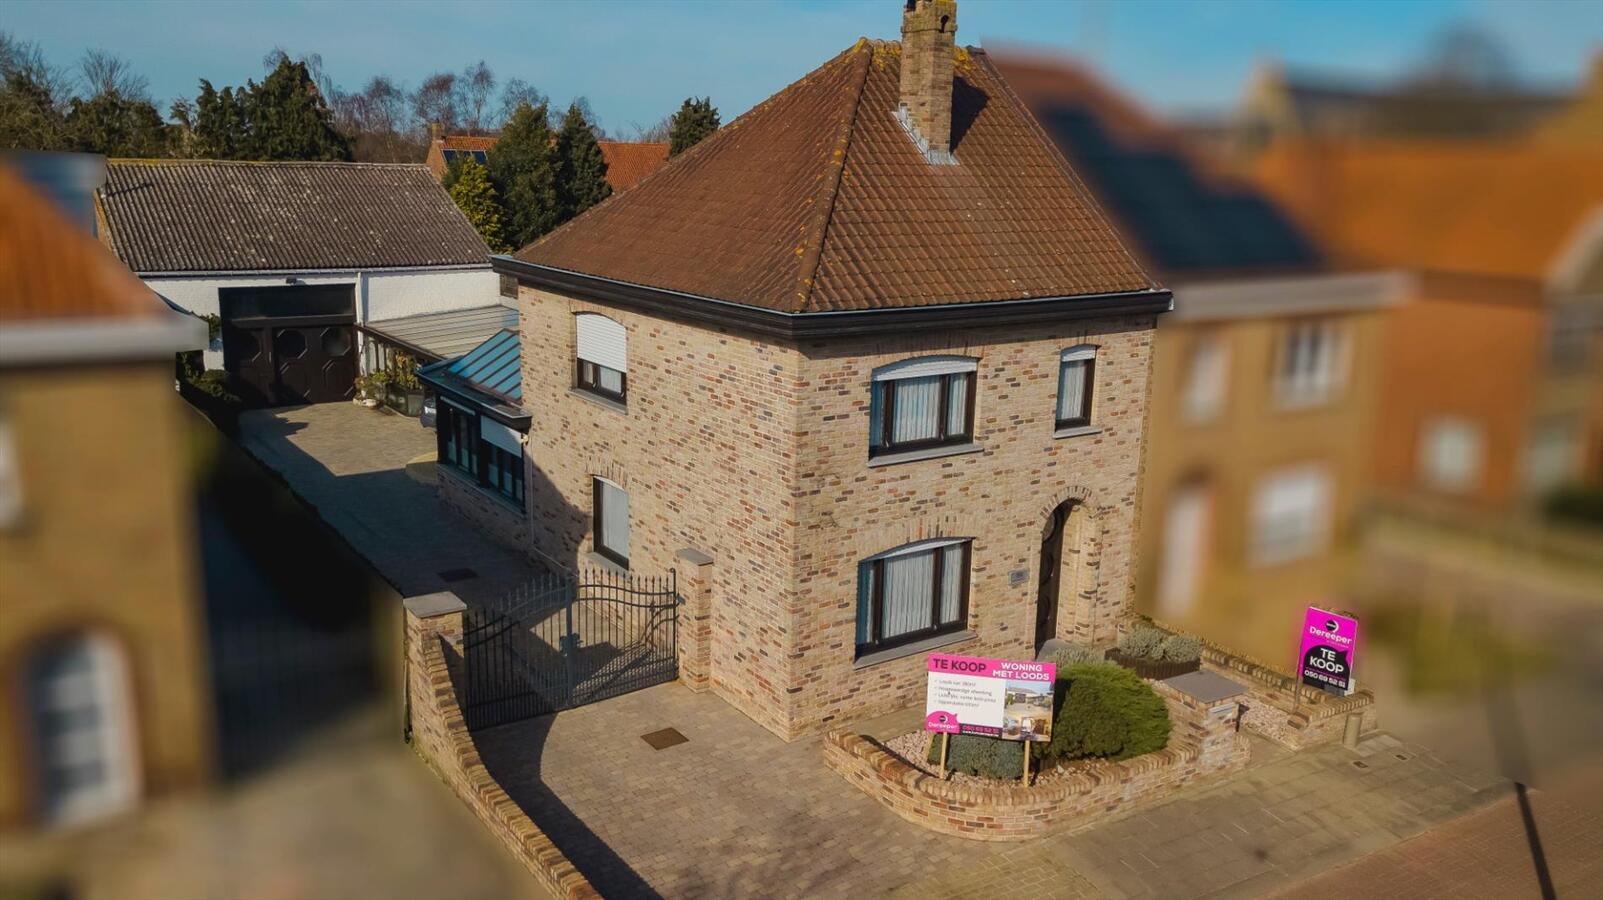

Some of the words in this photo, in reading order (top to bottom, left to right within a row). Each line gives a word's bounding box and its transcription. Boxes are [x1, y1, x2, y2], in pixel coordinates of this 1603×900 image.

[1309, 626, 1352, 645] Dereeper
[1320, 648, 1336, 661] TE
[933, 658, 948, 669] TE
[951, 660, 986, 673] KOOP
[1001, 662, 1043, 672] WONING
[1309, 656, 1344, 673] KOOP
[992, 670, 1013, 678] MET
[1015, 671, 1050, 681] LOODS
[1304, 669, 1318, 679] 050
[928, 721, 957, 729] Dereeper
